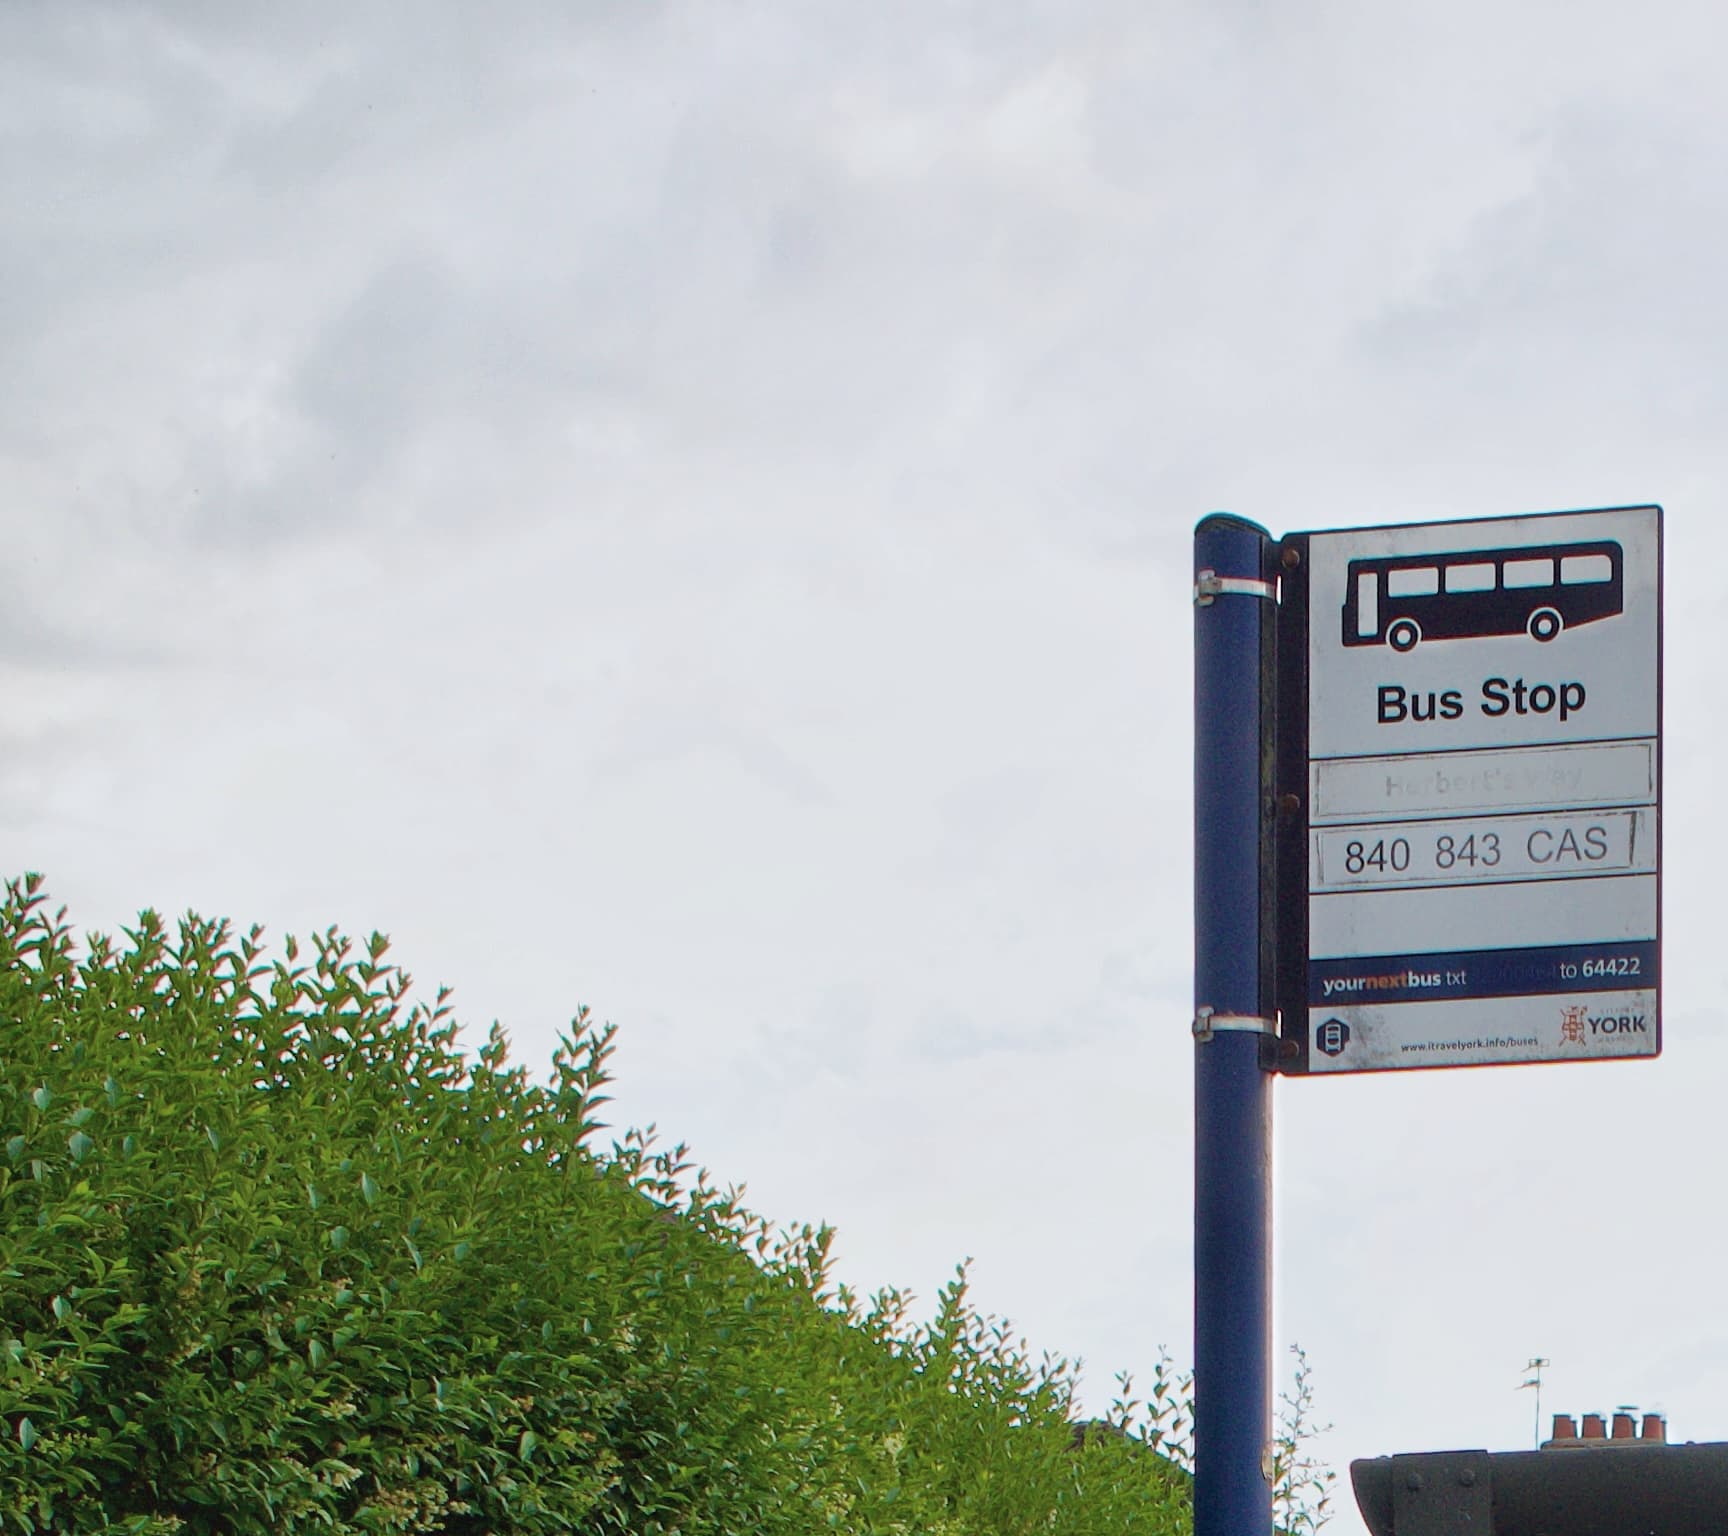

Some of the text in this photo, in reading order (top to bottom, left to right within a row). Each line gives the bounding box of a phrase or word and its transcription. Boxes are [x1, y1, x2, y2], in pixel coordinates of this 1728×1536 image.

[1378, 677, 1587, 723] Bus Stop
[1345, 826, 1608, 875] 840 843 CAS
[1323, 970, 1442, 996] yournextbus
[1446, 970, 1467, 986] txt
[1560, 962, 1578, 979] to
[1582, 957, 1641, 977] 64422
[1400, 1036, 1539, 1053] www.itravelyork.info/buses
[1587, 1015, 1647, 1035] YORK
